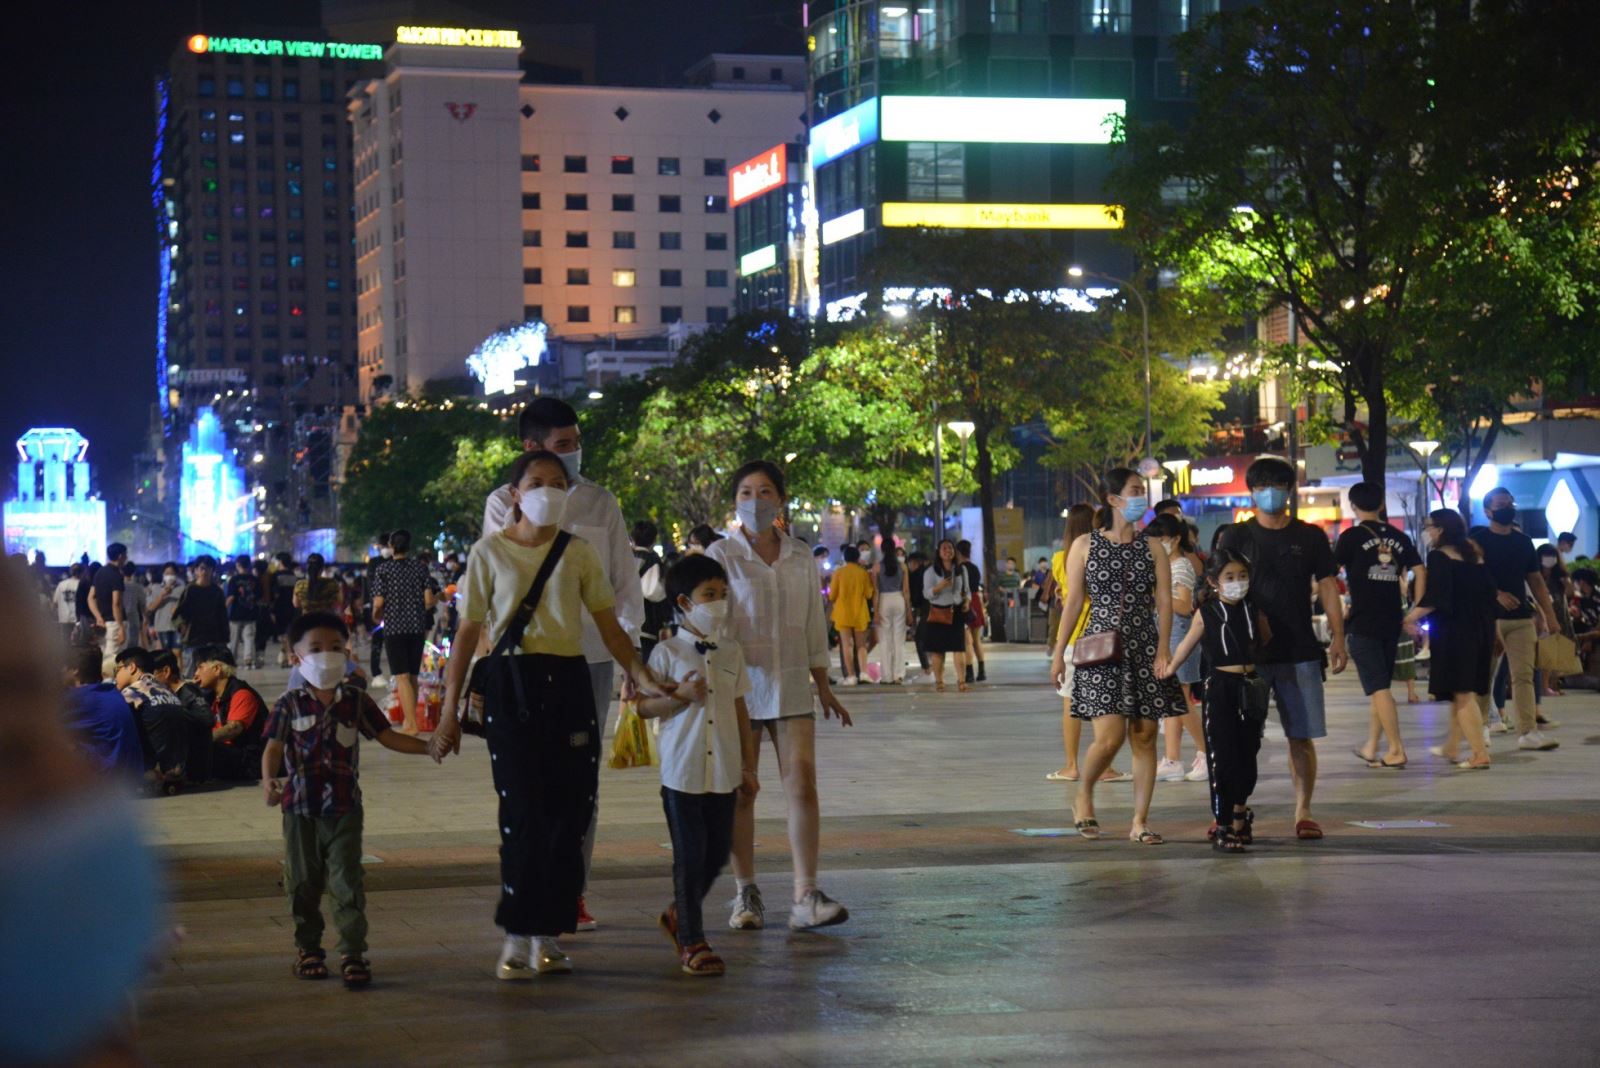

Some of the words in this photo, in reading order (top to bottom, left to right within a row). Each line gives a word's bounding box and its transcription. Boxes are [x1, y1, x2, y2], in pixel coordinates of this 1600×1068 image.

[208, 37, 283, 55] HARBOUR
[285, 40, 325, 57] VIEW
[326, 42, 382, 60] TOWER
[980, 207, 1049, 228] Maybank
